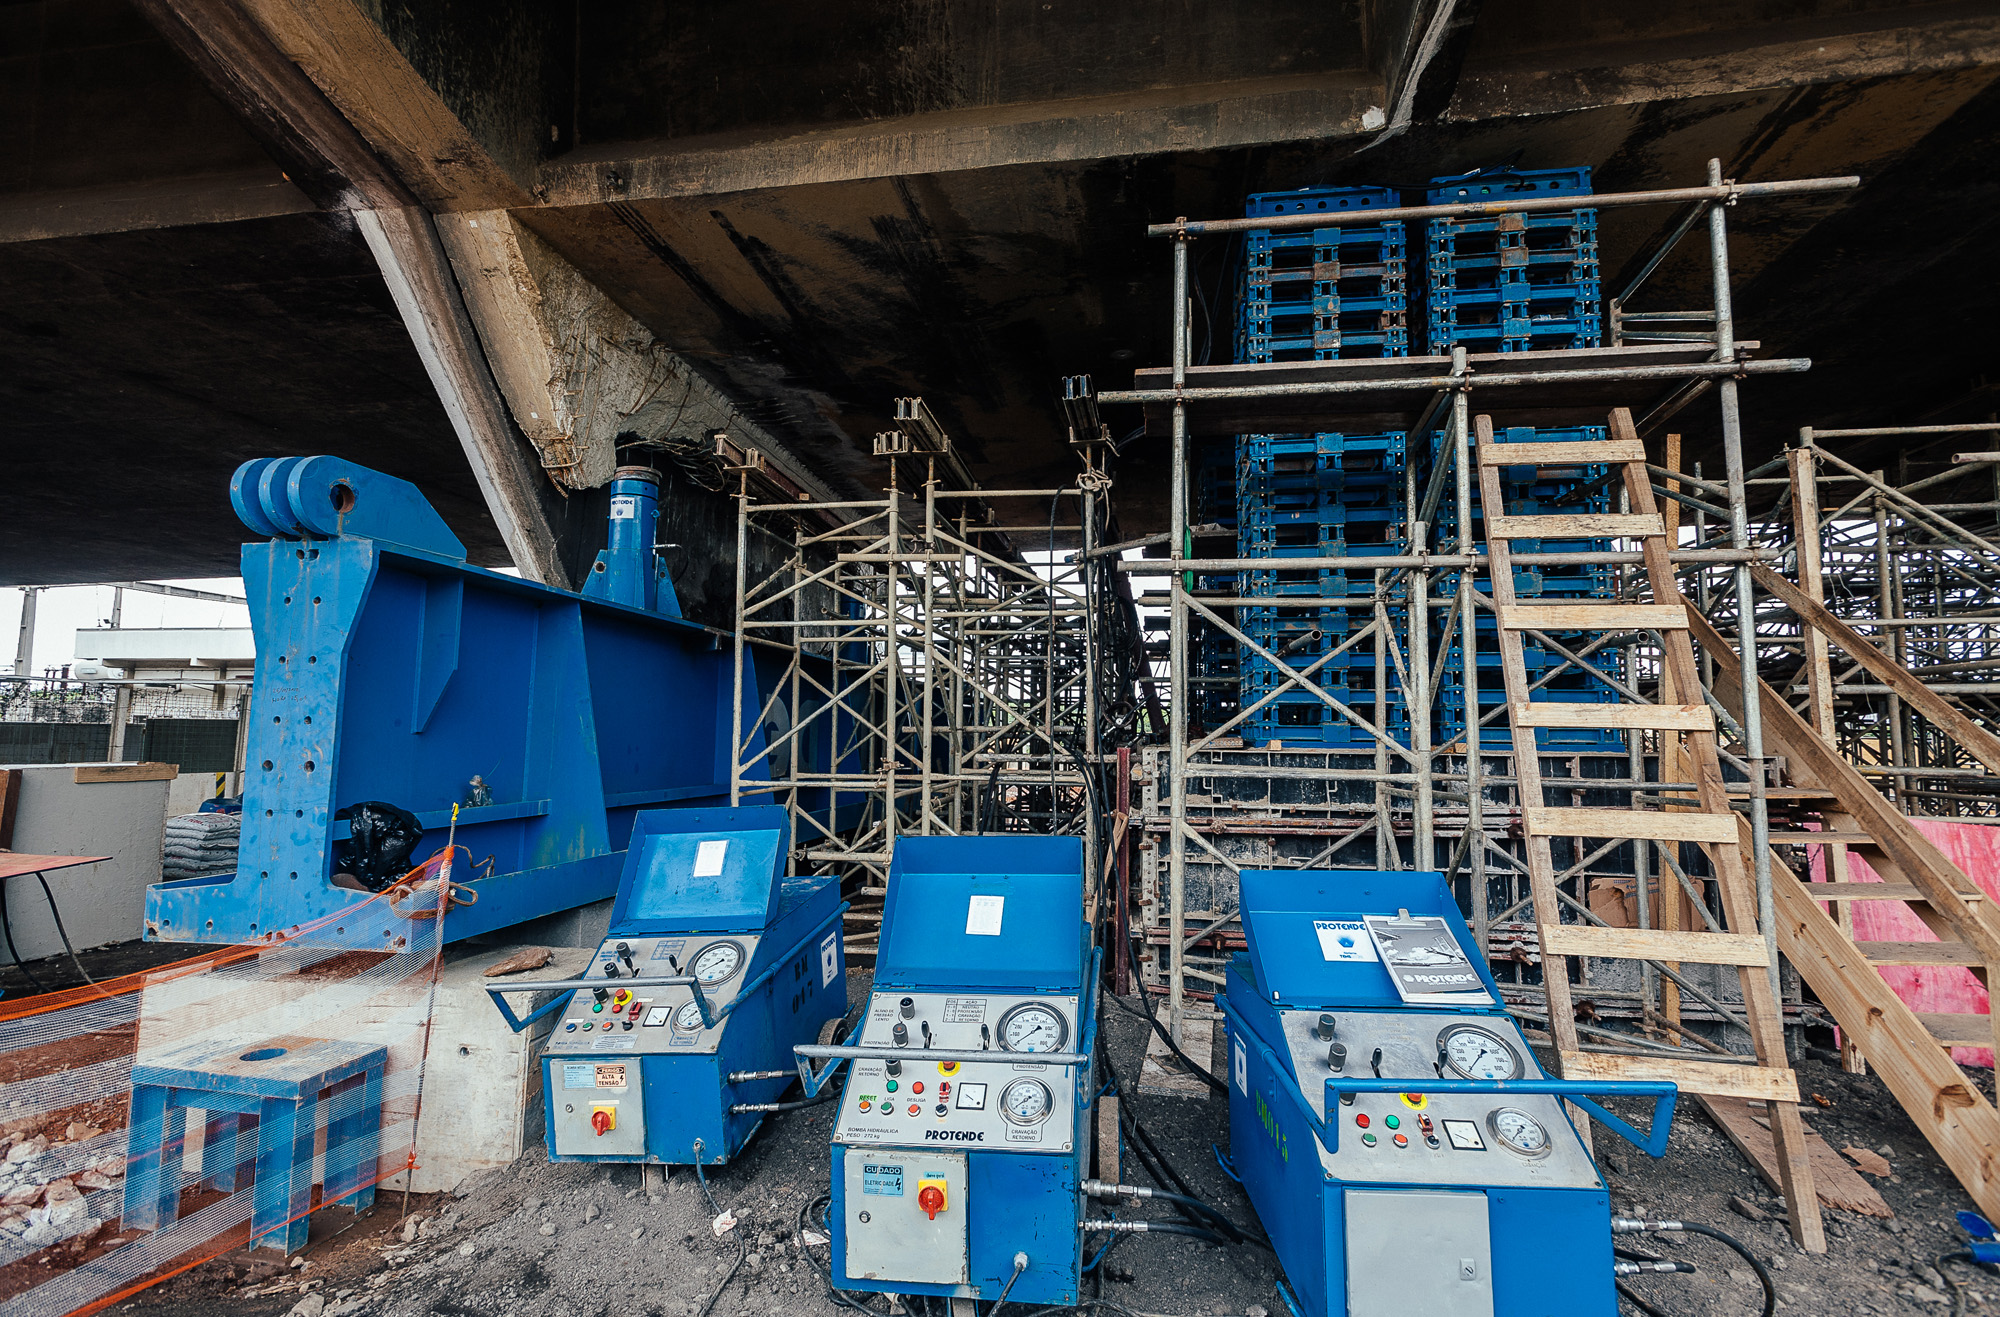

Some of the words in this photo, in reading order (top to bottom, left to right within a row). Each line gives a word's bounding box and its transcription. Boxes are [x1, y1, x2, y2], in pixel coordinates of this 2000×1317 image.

[1316, 923, 1366, 931] PROTENDE
[1415, 974, 1475, 983] PROTENDE
[925, 1130, 984, 1141] PROTENDE
